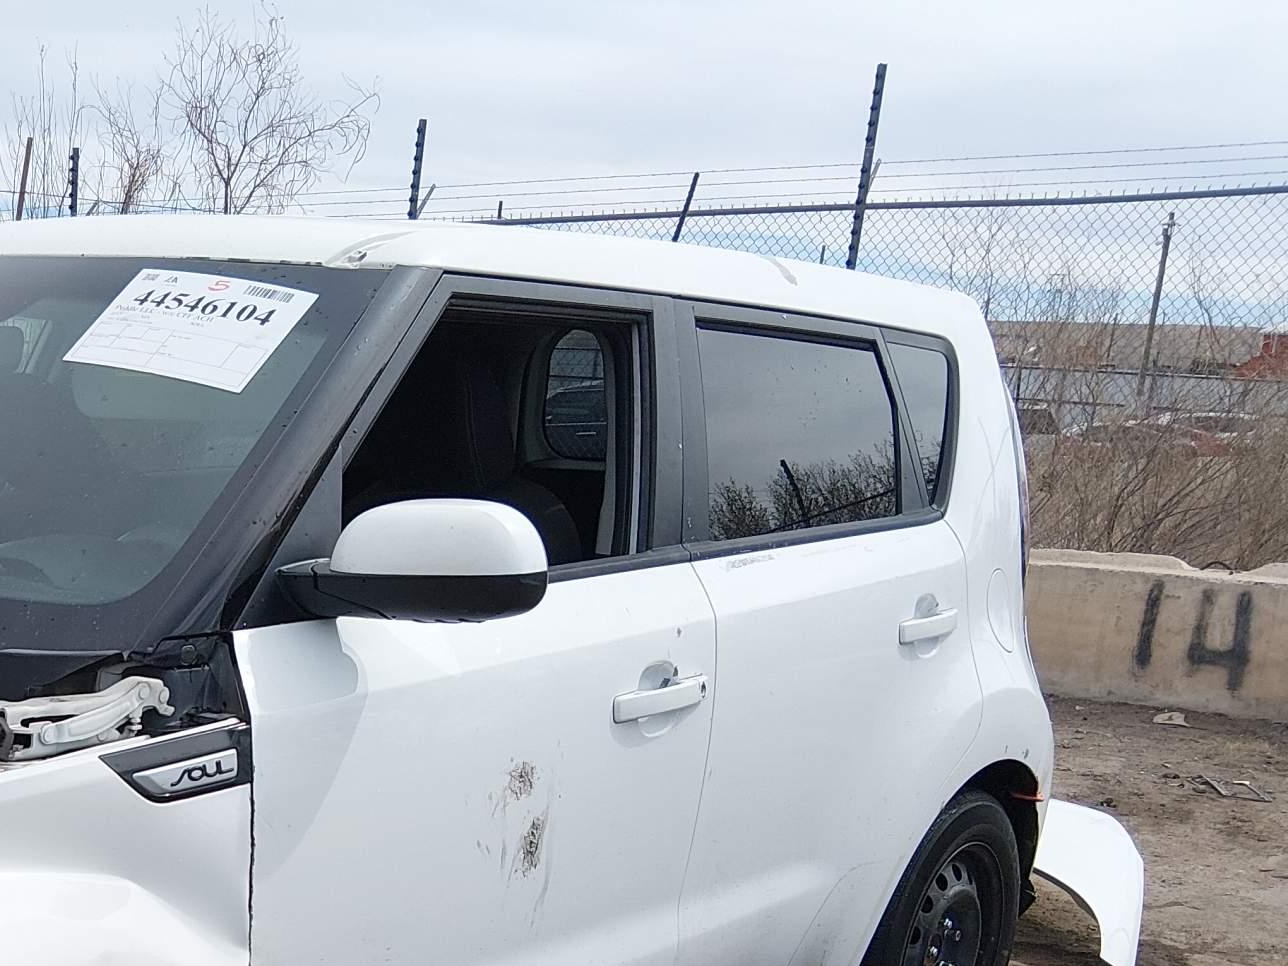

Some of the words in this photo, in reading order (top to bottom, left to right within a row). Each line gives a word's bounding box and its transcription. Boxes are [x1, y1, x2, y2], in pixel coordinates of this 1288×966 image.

[133, 289, 277, 326] 44546104
[1131, 579, 1253, 696] 14
[170, 760, 234, 788] SOUL
